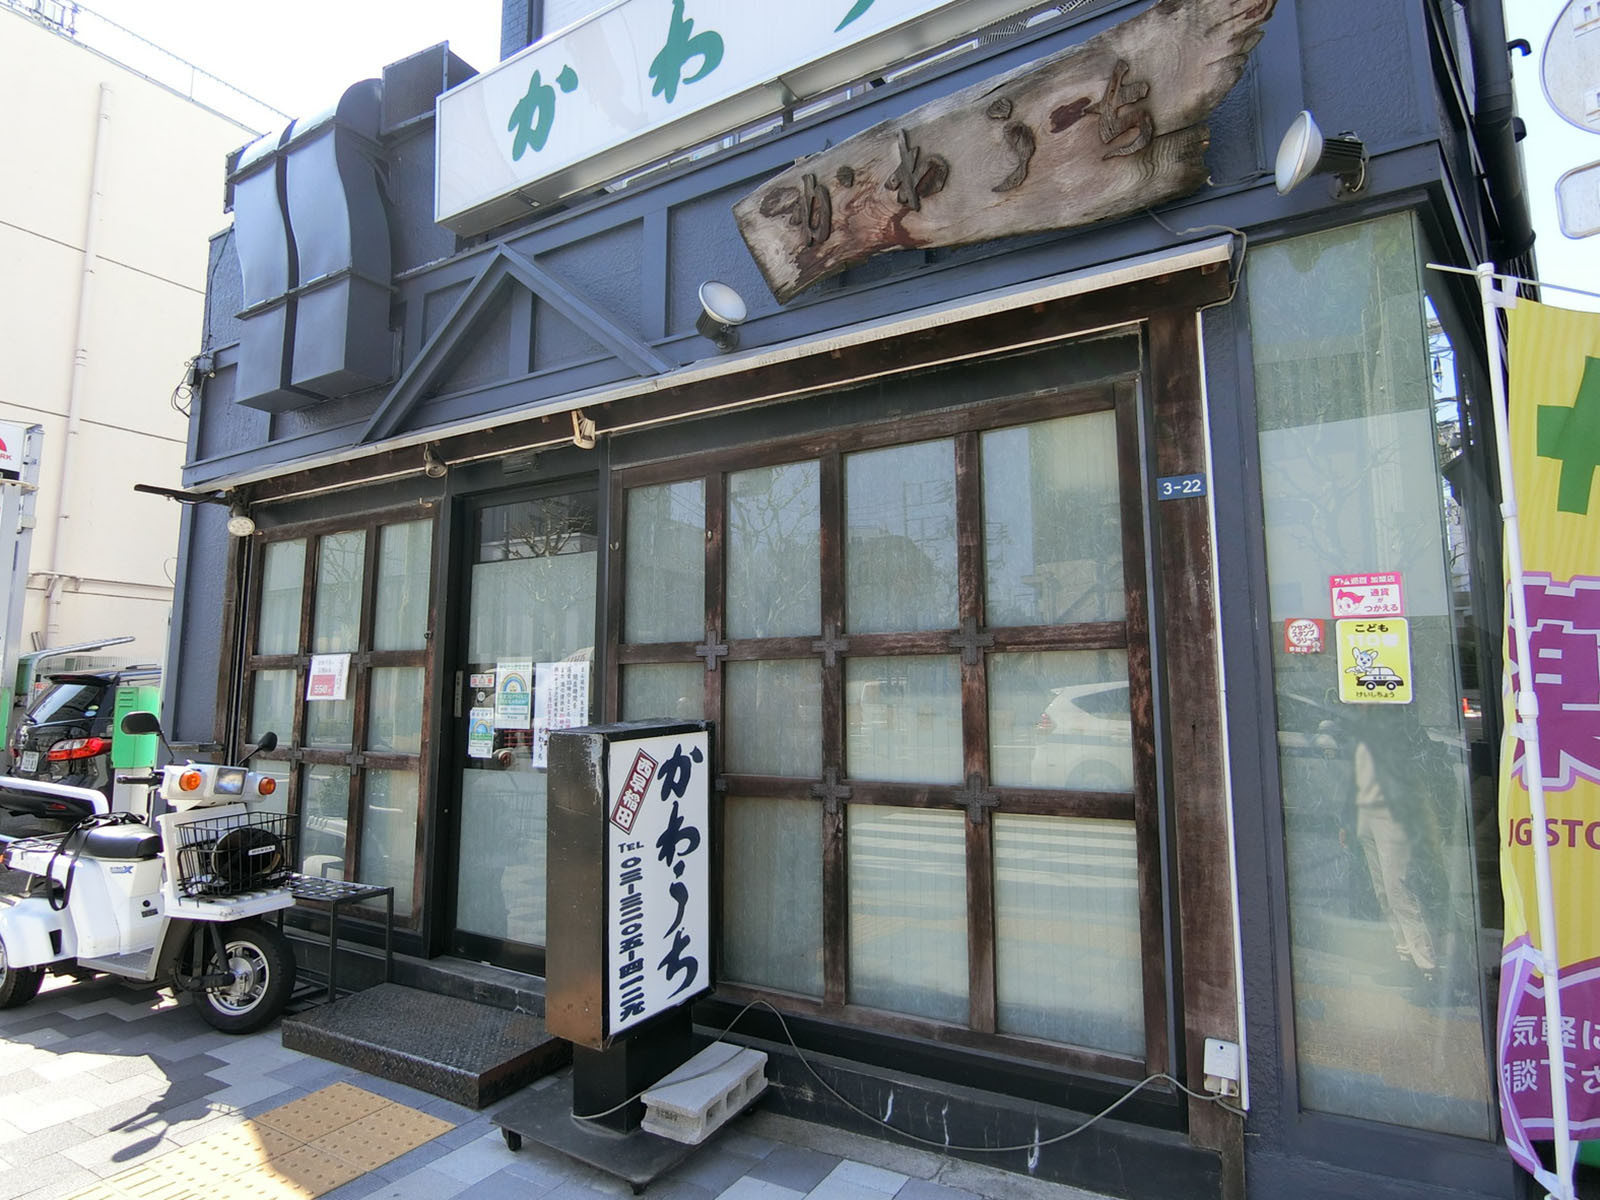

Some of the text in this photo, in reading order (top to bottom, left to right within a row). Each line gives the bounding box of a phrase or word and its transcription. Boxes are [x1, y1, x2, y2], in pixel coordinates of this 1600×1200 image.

[508, 0, 876, 161] かわ
[1163, 479, 1201, 495] 3-22
[1364, 603, 1399, 613] つかえる
[1355, 623, 1389, 633] こども
[616, 756, 655, 830] 西早稲田
[1508, 818, 1532, 847] G
[618, 841, 645, 853] TEL
[657, 744, 703, 999] かわうち
